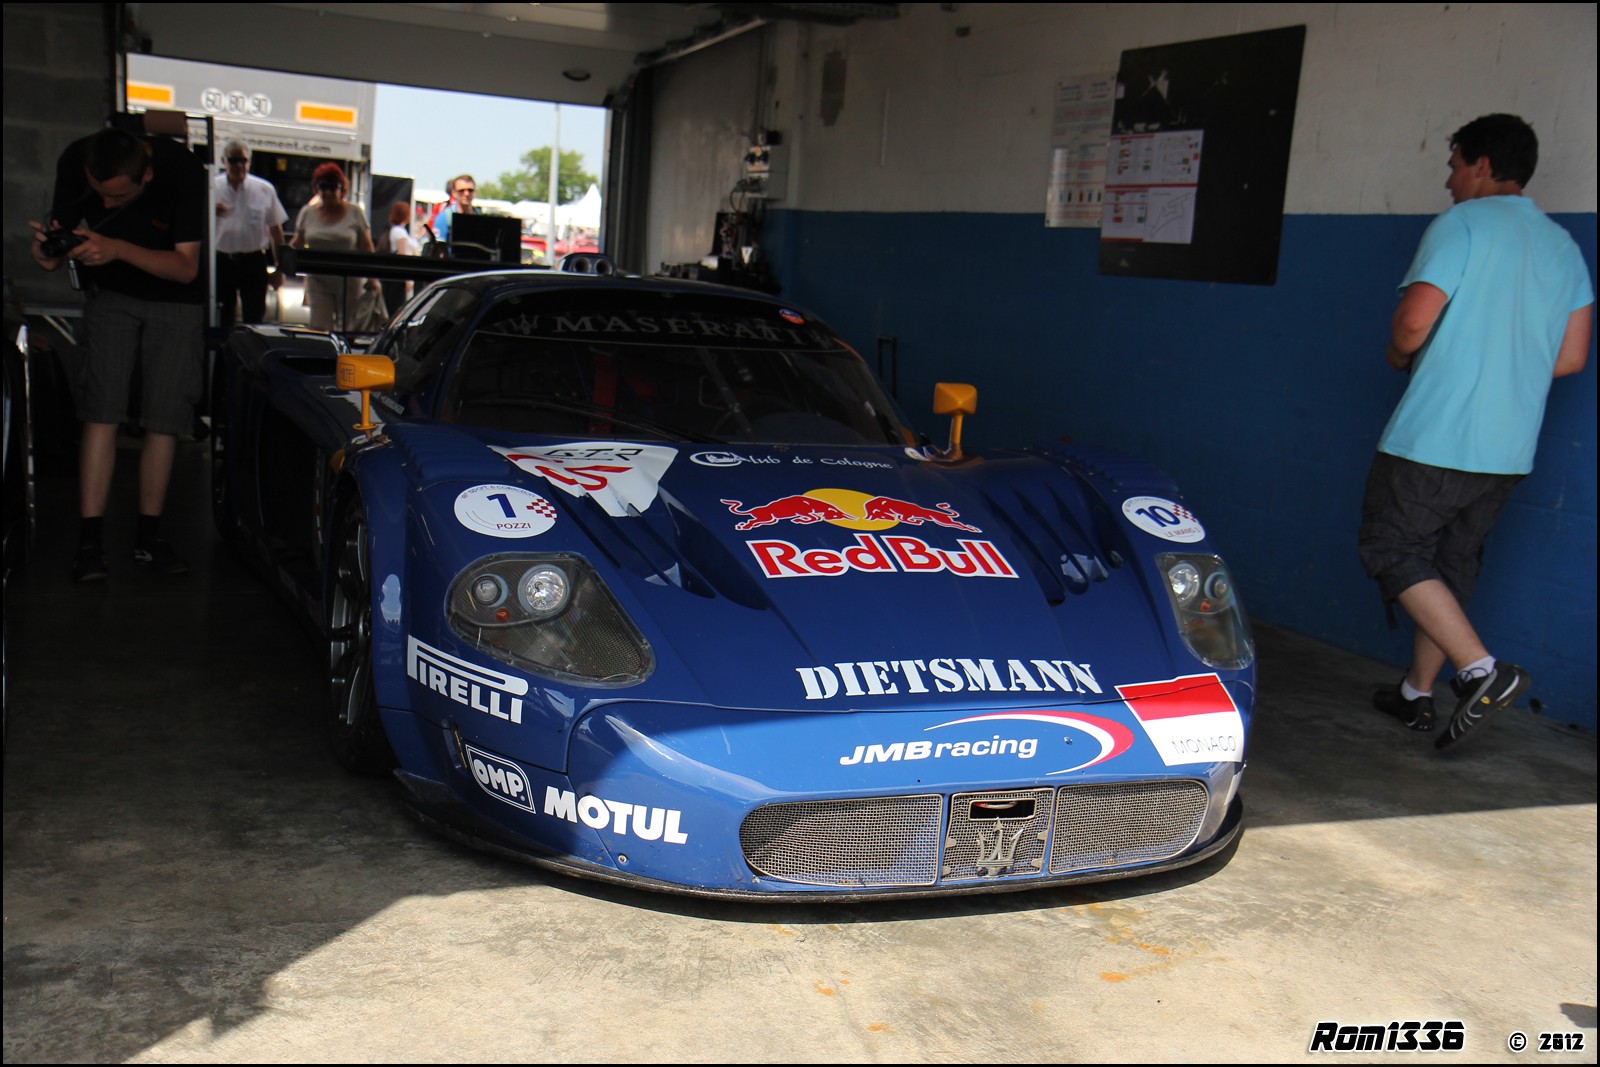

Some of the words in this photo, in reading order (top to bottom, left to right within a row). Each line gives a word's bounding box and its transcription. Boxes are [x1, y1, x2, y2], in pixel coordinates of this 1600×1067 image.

[552, 313, 809, 346] MASERATI
[792, 456, 814, 465] de
[820, 457, 894, 470] Cologne
[486, 493, 517, 519] 1
[1135, 505, 1181, 527] 10
[496, 522, 532, 530] POZZI
[747, 533, 897, 578] Red
[880, 535, 1019, 578] Bull
[406, 634, 529, 724] PIRELLI
[795, 657, 1103, 700] DIETSMANN
[1171, 735, 1237, 755] MONACO
[473, 758, 525, 800] OMP
[543, 785, 689, 845] MOTUL
